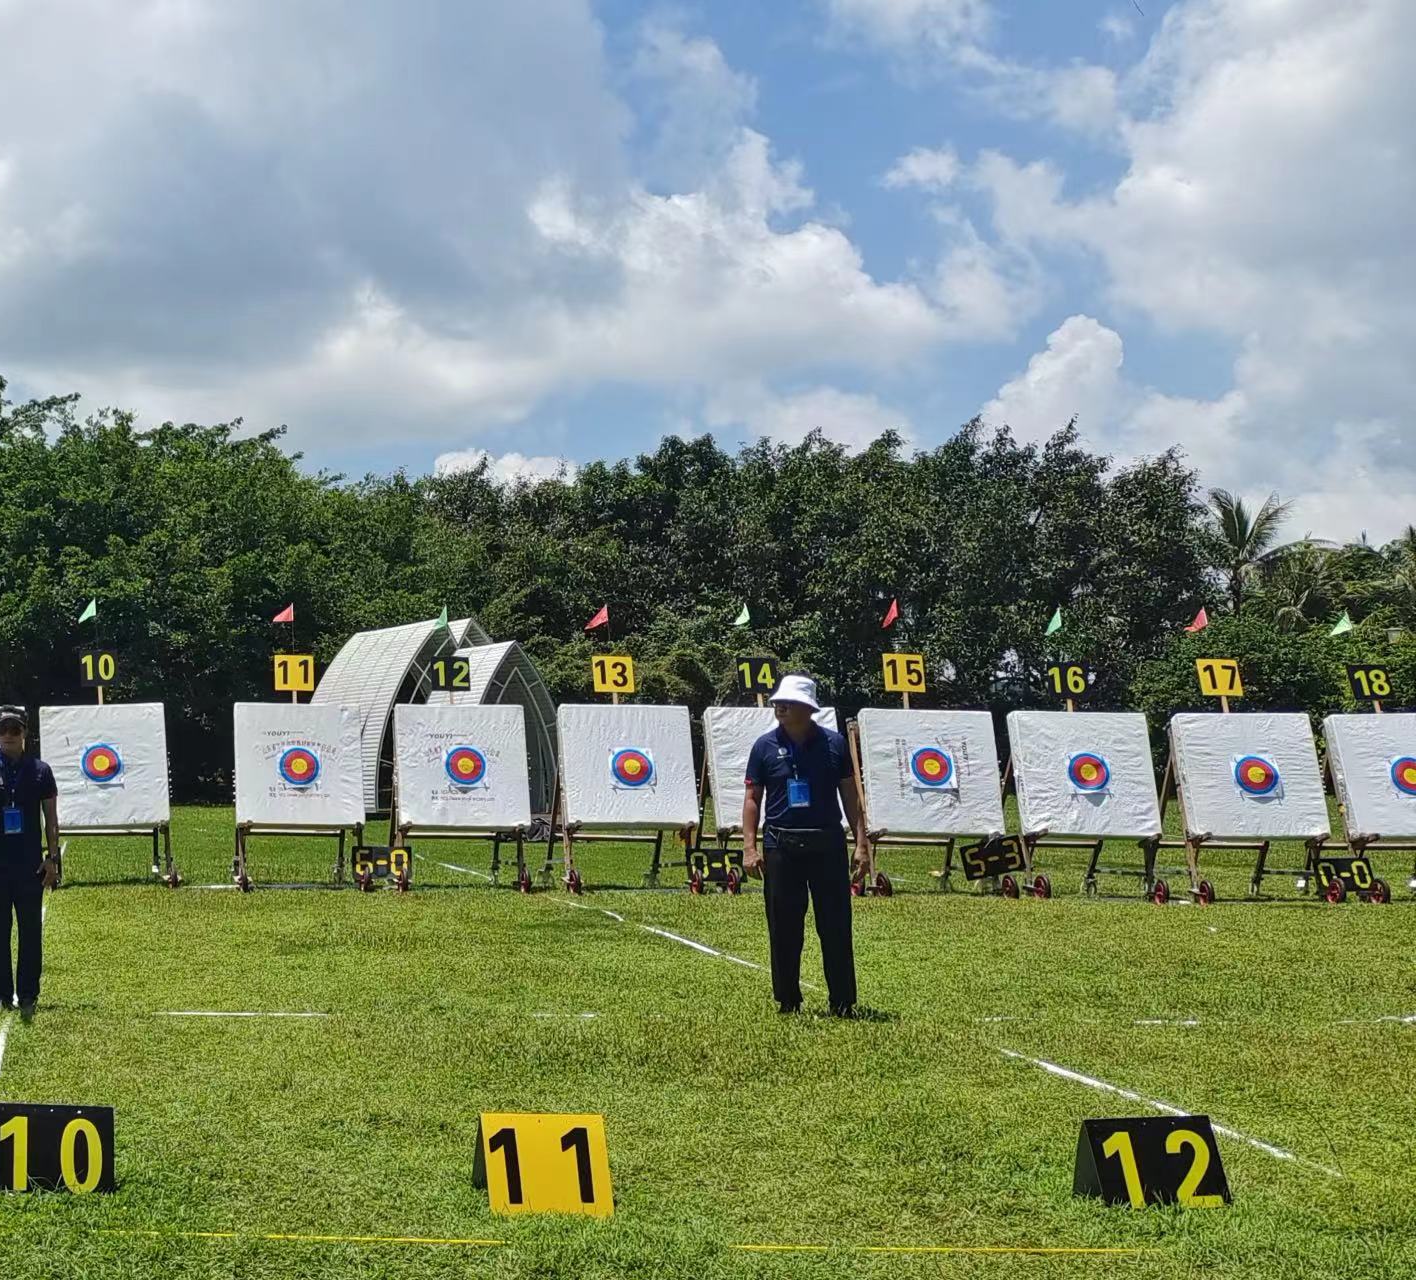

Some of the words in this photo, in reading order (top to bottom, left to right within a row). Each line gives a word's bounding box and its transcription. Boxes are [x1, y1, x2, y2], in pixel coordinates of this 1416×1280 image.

[81, 653, 115, 681] 10
[277, 660, 310, 685] 11
[433, 660, 470, 687] 12
[594, 659, 628, 687] 13
[738, 662, 775, 689] 14
[885, 659, 923, 687] 15
[1048, 666, 1086, 694] 16
[1203, 664, 1237, 690] 17
[1354, 669, 1391, 696] 18
[965, 840, 1021, 877] 5-3
[0, 1116, 103, 1194] 10
[489, 1127, 595, 1204] 11
[1102, 1129, 1224, 1208] 12
